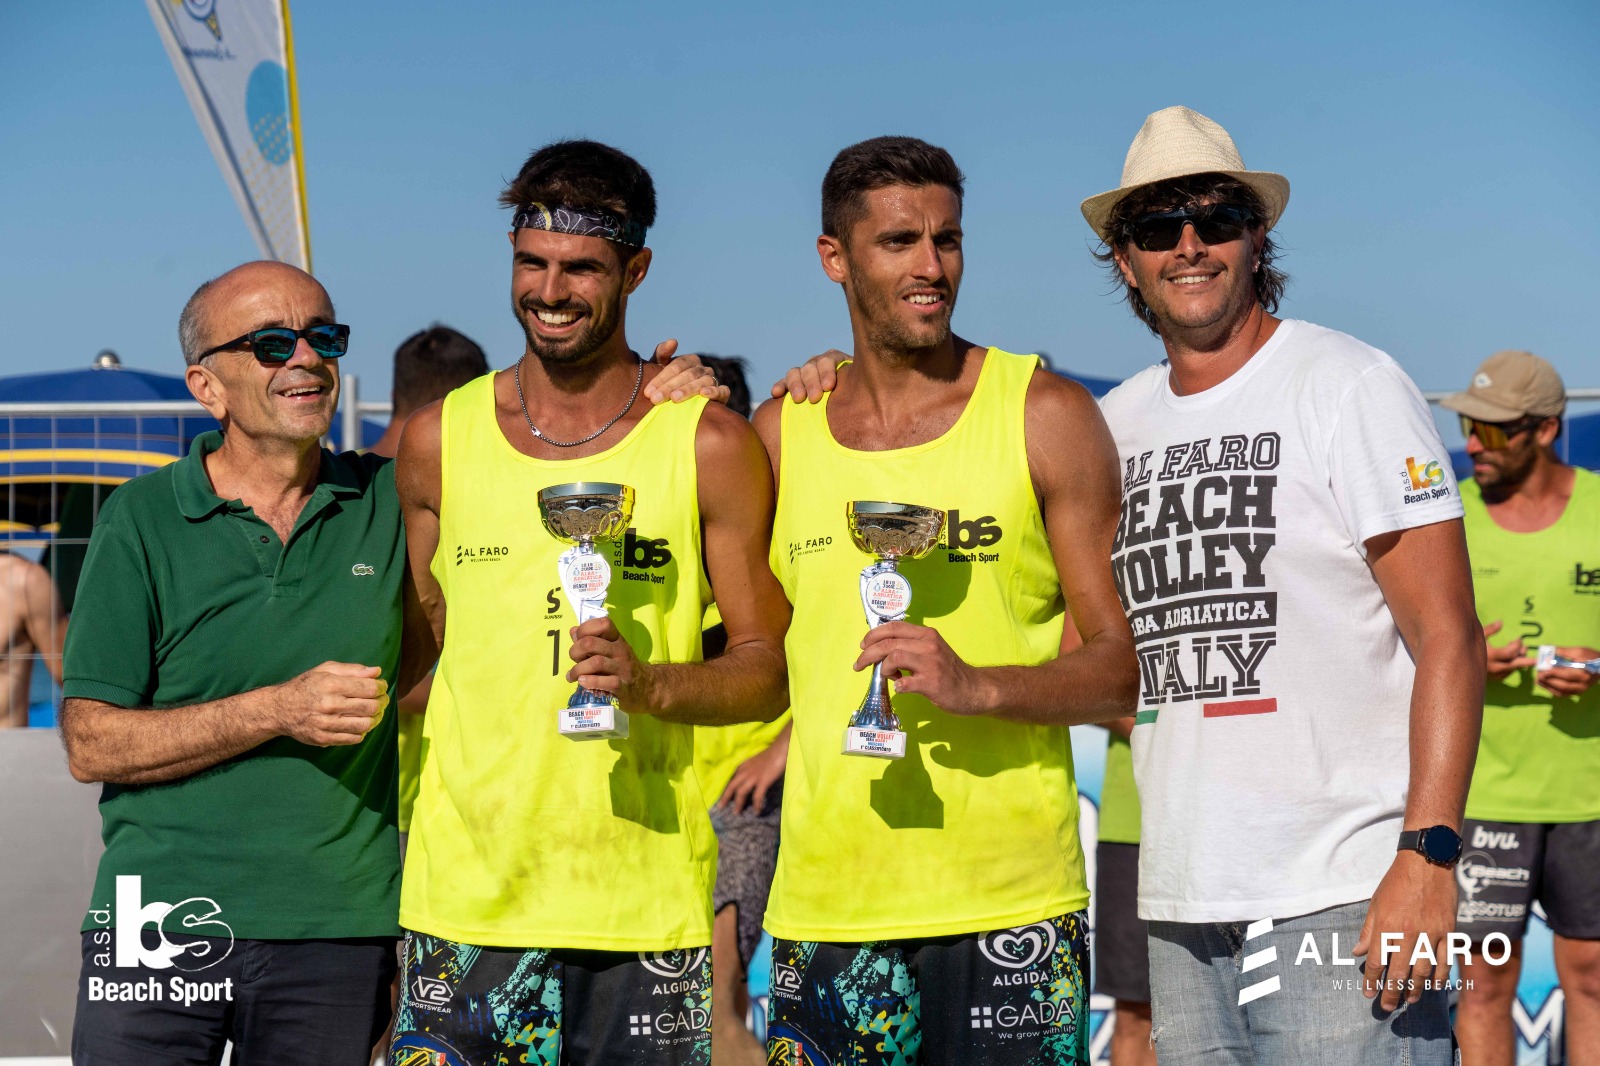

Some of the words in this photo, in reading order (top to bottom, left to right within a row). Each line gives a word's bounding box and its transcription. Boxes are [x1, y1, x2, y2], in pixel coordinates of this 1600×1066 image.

[1123, 449, 1154, 497] AL
[1157, 431, 1281, 481] FARO
[1403, 490, 1431, 505] Beach
[1431, 486, 1450, 500] Sport
[1111, 475, 1278, 556] BEACH
[464, 547, 476, 557] AL
[479, 546, 509, 556] FARO
[793, 542, 802, 553] AL
[805, 536, 833, 549] FARO
[948, 552, 977, 563] Beach
[978, 552, 1000, 564] Sport
[622, 570, 650, 582] Beach
[650, 572, 666, 585] Sport
[1111, 532, 1276, 614] VOLLEY
[1163, 600, 1270, 631] ADRIATICA
[1471, 825, 1520, 850] bvu.
[652, 979, 700, 996] ALGIDA
[993, 971, 1050, 987] ALGIDA
[417, 975, 451, 1002] V2
[408, 1000, 452, 1014] SPORTSWEAR
[996, 999, 1076, 1028] GADA
[656, 1038, 671, 1046] We
[672, 1036, 693, 1046] grow
[694, 1032, 711, 1042] with
[998, 1031, 1013, 1039] We
[1017, 1030, 1041, 1040] grow
[1043, 1025, 1060, 1035] with
[1063, 1024, 1076, 1034] life
